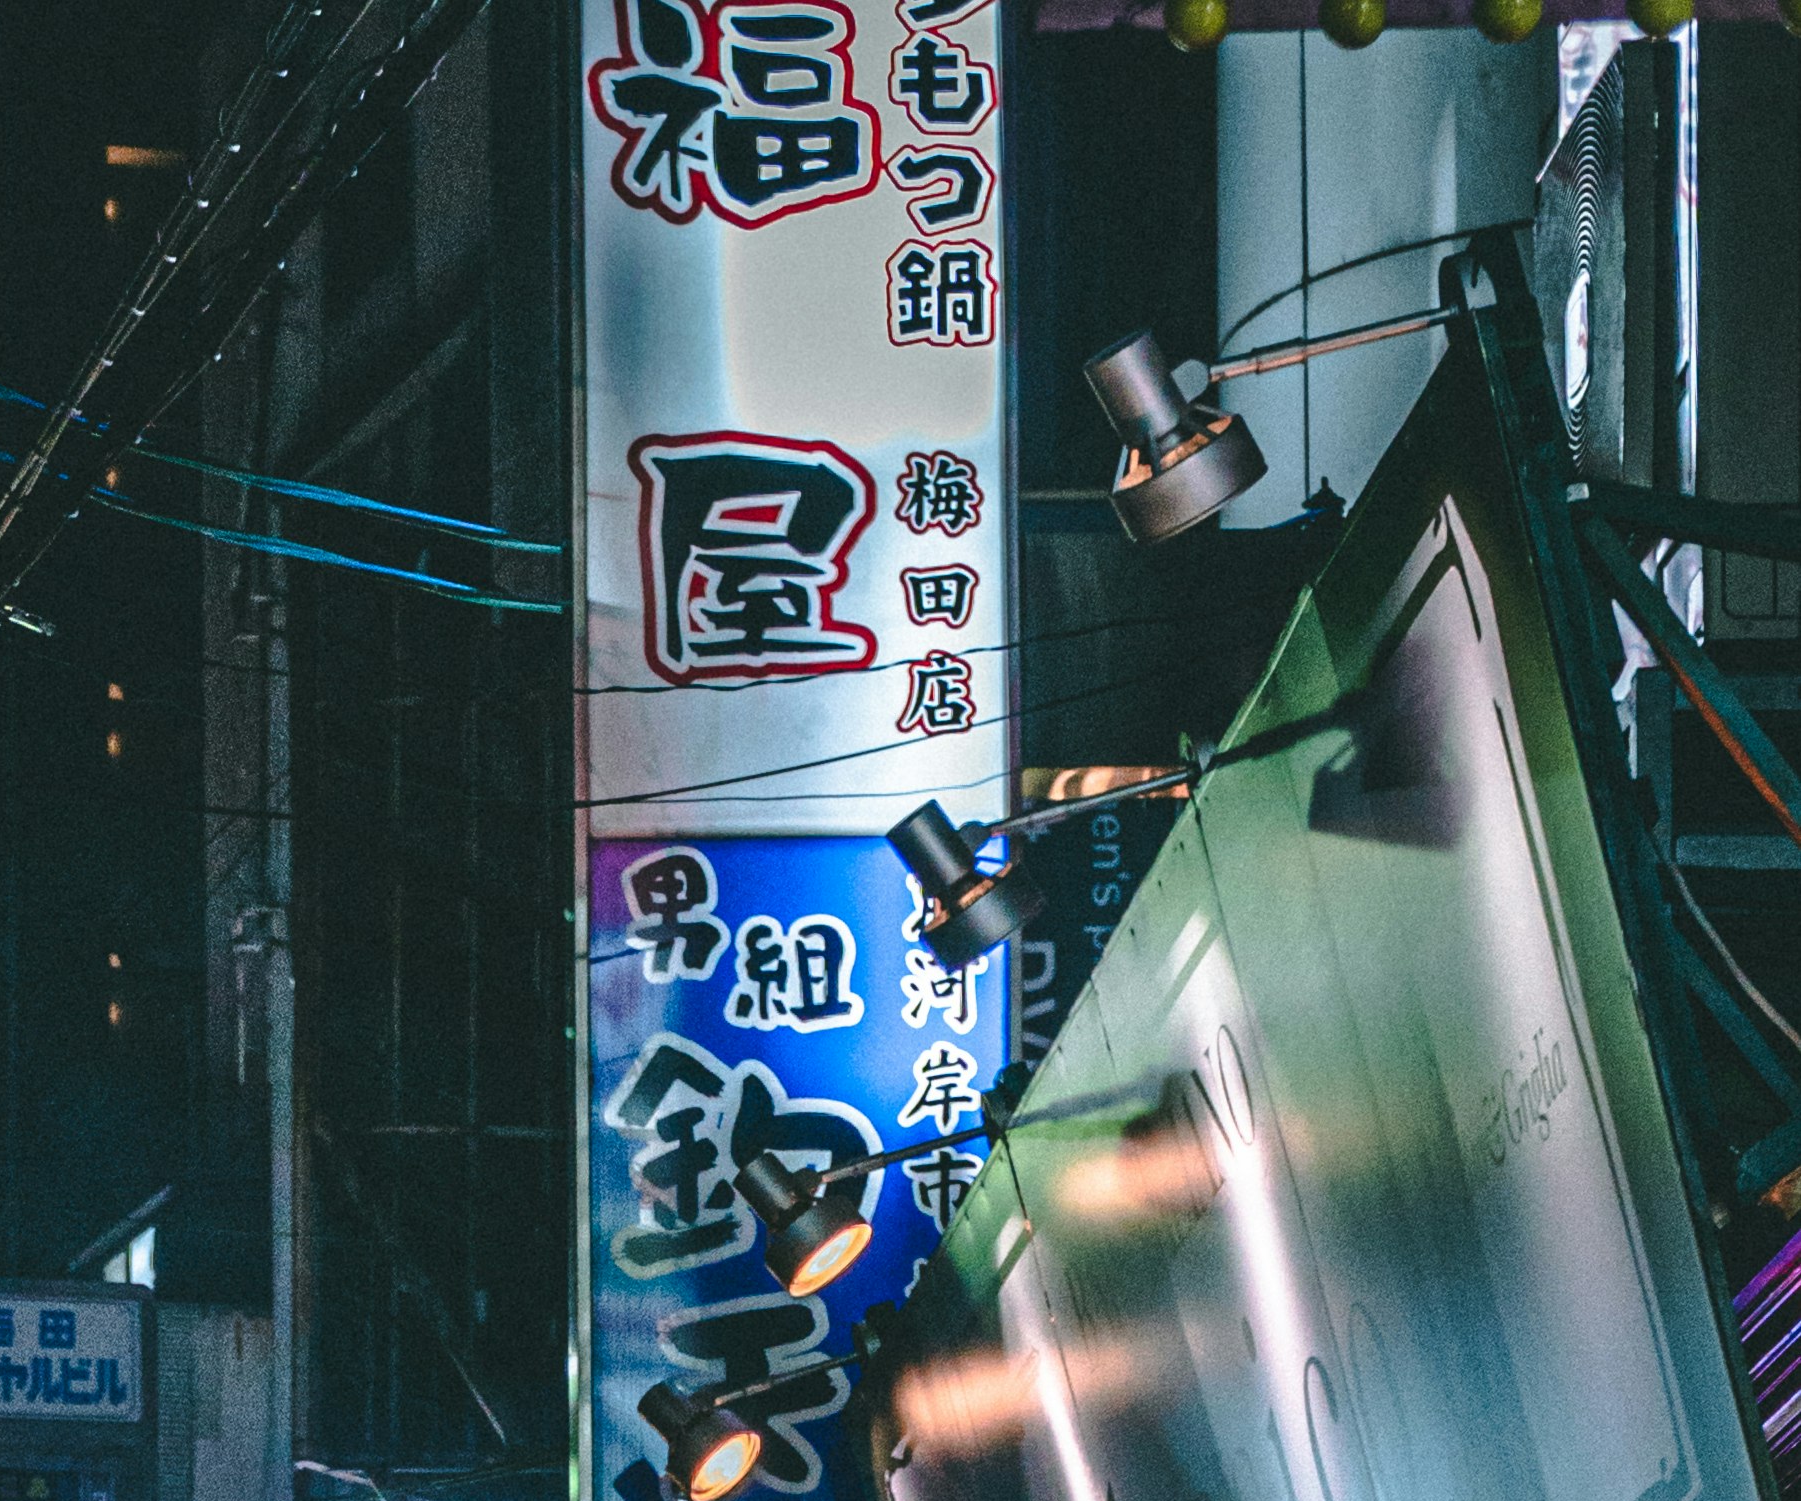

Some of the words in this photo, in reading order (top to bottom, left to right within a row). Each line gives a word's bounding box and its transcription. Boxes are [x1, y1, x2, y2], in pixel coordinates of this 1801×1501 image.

[897, 450, 983, 735] 梅田店
[622, 846, 865, 1032] 男組
[1091, 800, 1132, 907] en's
[899, 872, 989, 1297] 河岸市
